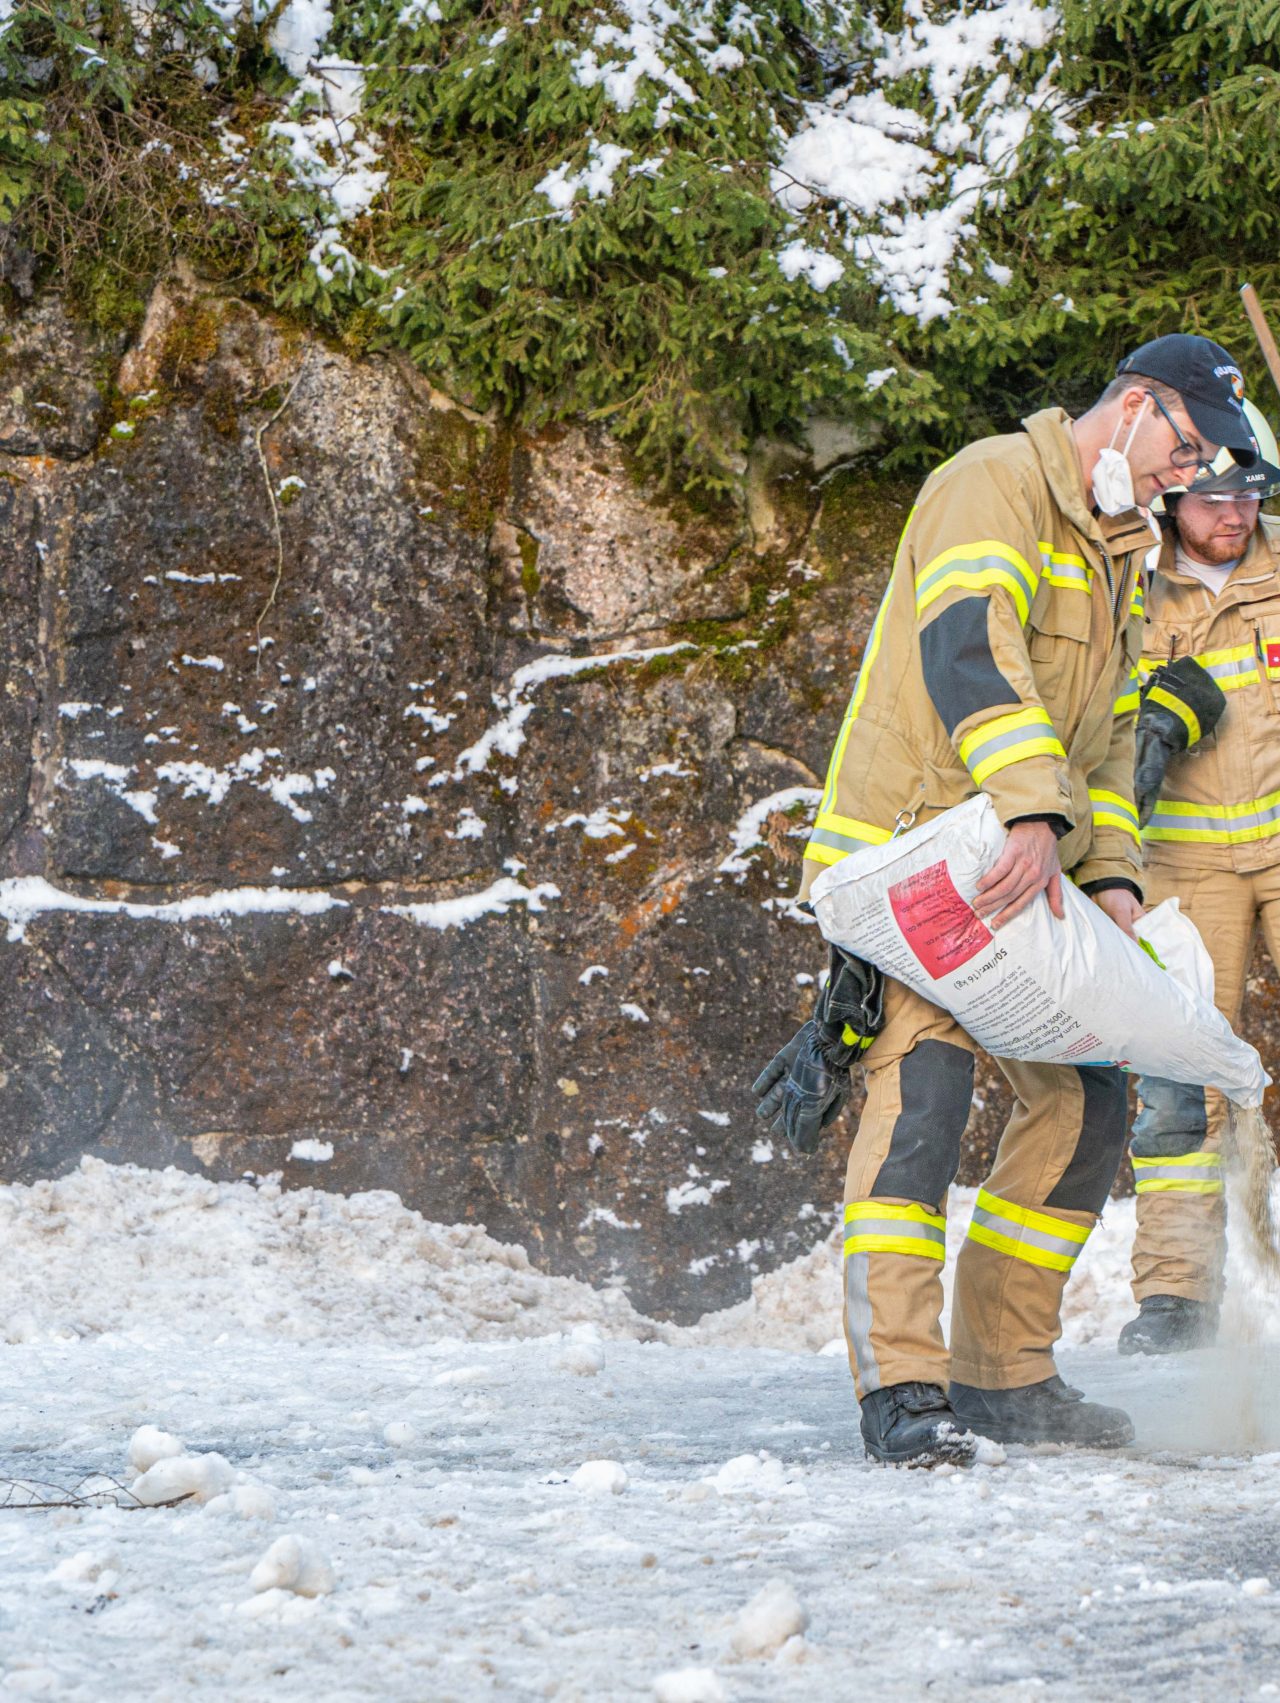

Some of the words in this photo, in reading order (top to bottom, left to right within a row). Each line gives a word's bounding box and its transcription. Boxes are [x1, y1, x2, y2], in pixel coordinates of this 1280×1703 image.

[1045, 1008, 1066, 1026] 100%
[1058, 1014, 1073, 1026] von
[1061, 1019, 1082, 1035] Zum
